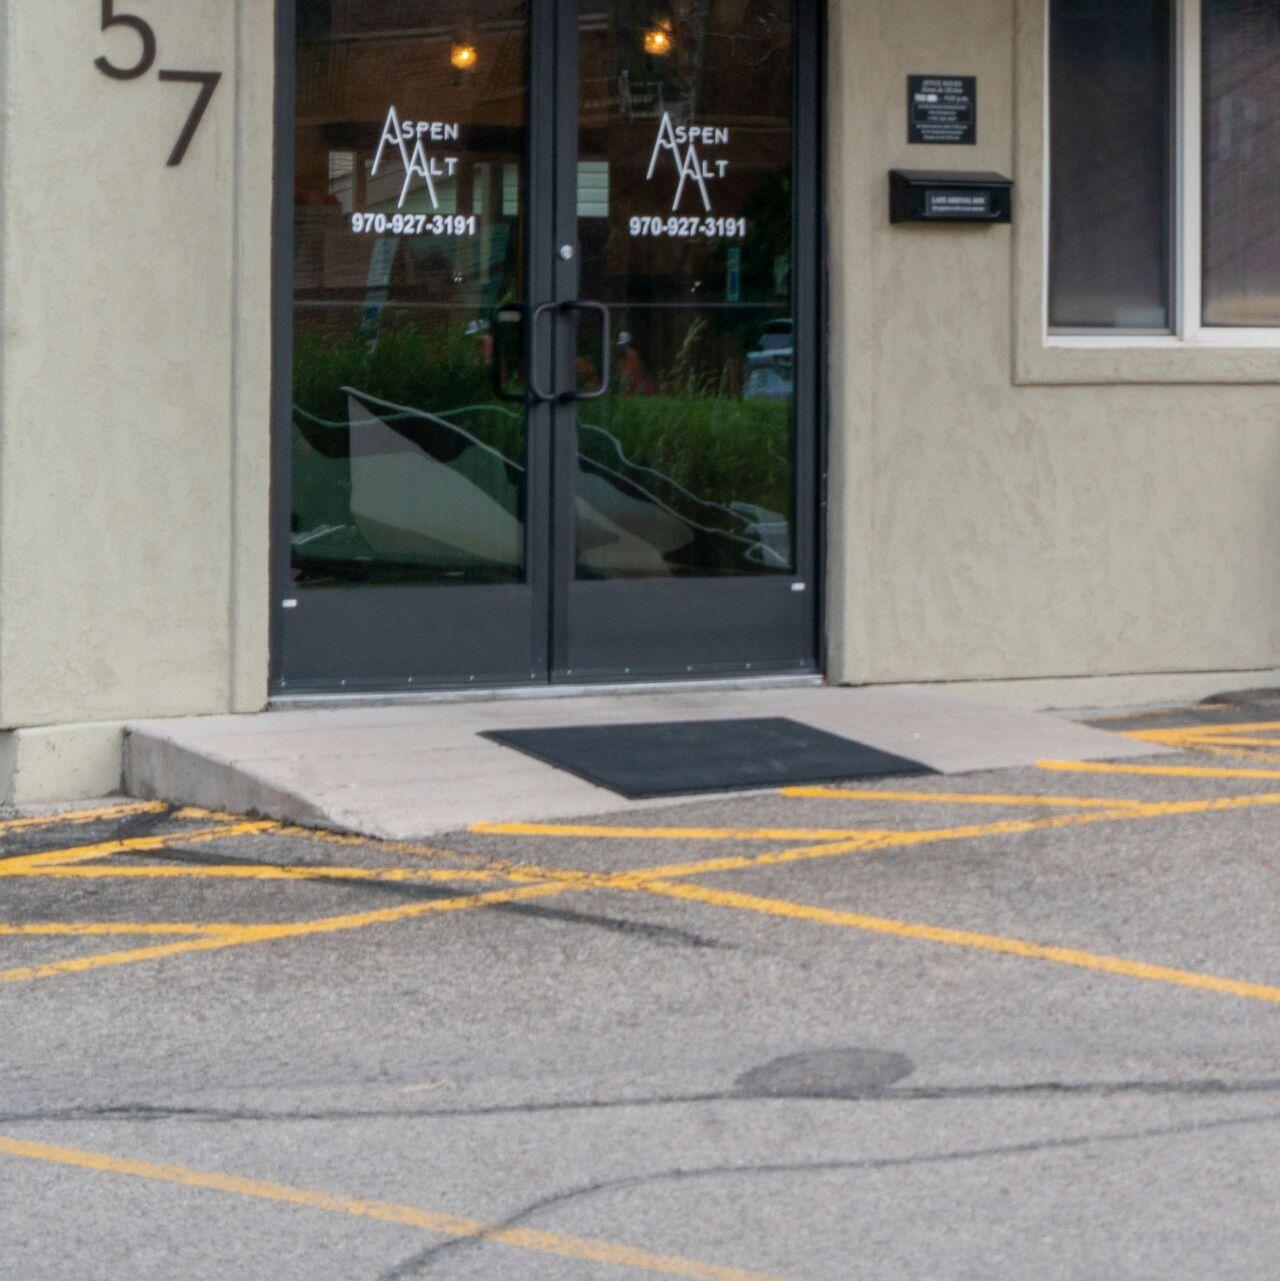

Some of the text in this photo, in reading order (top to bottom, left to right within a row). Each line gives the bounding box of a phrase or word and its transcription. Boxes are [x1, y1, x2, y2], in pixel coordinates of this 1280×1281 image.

[370, 105, 459, 177] ASPEN
[397, 139, 458, 209] ALT
[646, 111, 729, 180] ASPEN
[672, 144, 728, 212] ALT
[351, 212, 476, 236] 970-927-3191
[629, 216, 746, 237] 970-927-3191
